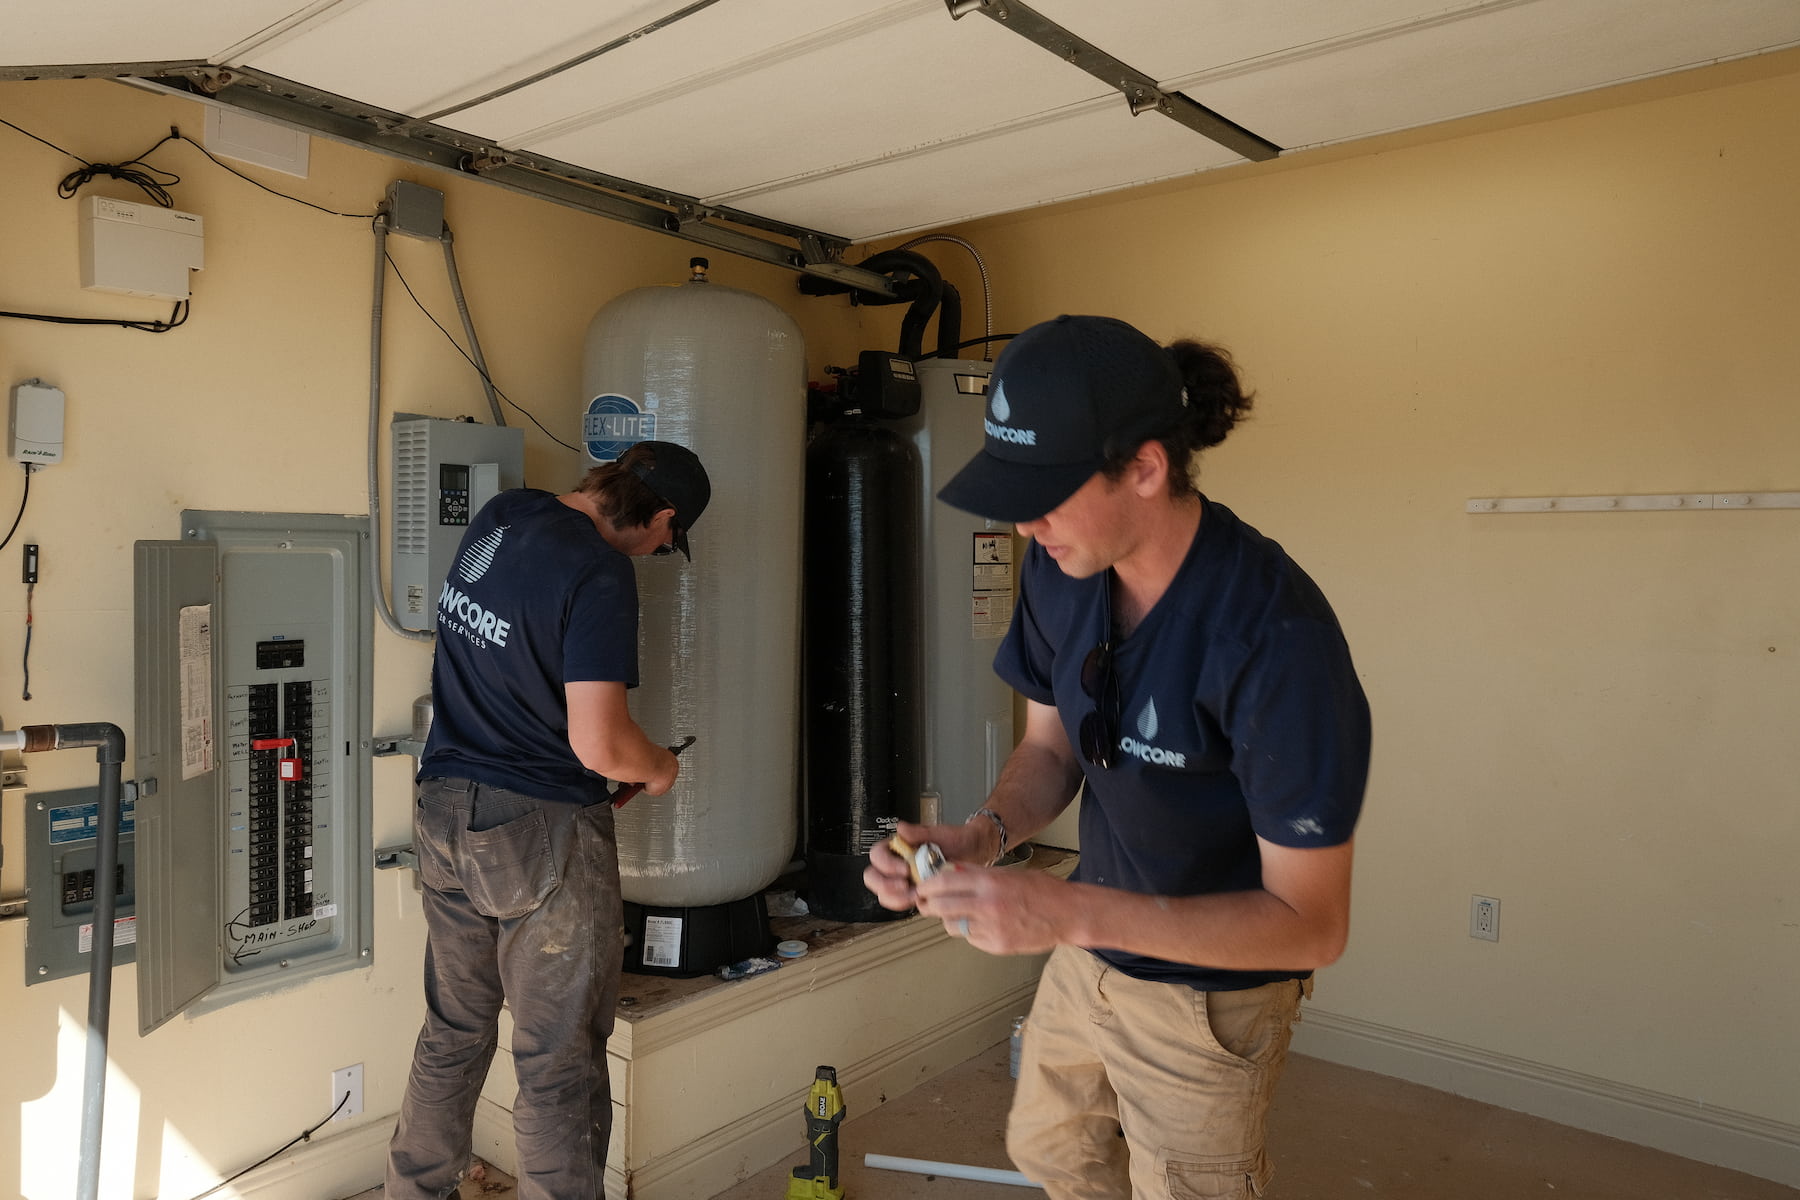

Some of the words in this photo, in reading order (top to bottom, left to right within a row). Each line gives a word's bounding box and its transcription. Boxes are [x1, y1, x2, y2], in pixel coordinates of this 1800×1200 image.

[439, 580, 511, 648] WCORE
[447, 620, 487, 650] SERVICES
[1119, 736, 1186, 769] OWCORE
